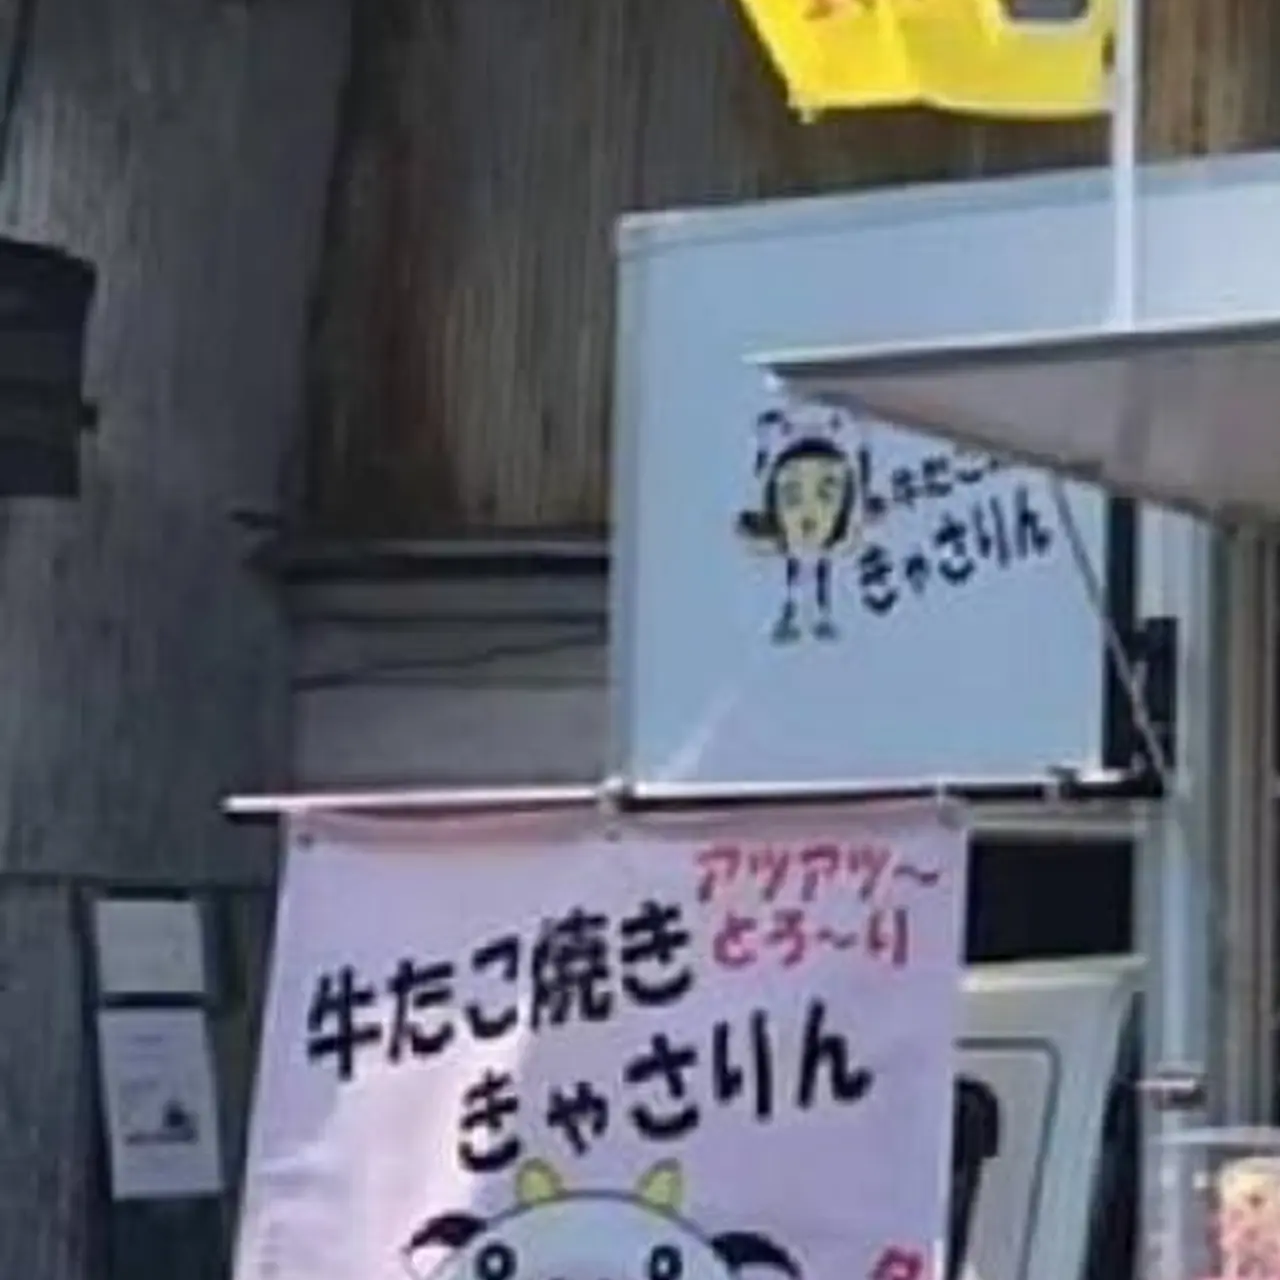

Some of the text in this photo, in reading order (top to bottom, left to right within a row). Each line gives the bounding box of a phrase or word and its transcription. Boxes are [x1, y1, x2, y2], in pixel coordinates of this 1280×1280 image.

[306, 899, 694, 1081] 牛たこ焼き
[457, 999, 872, 1173] きゃさりん
